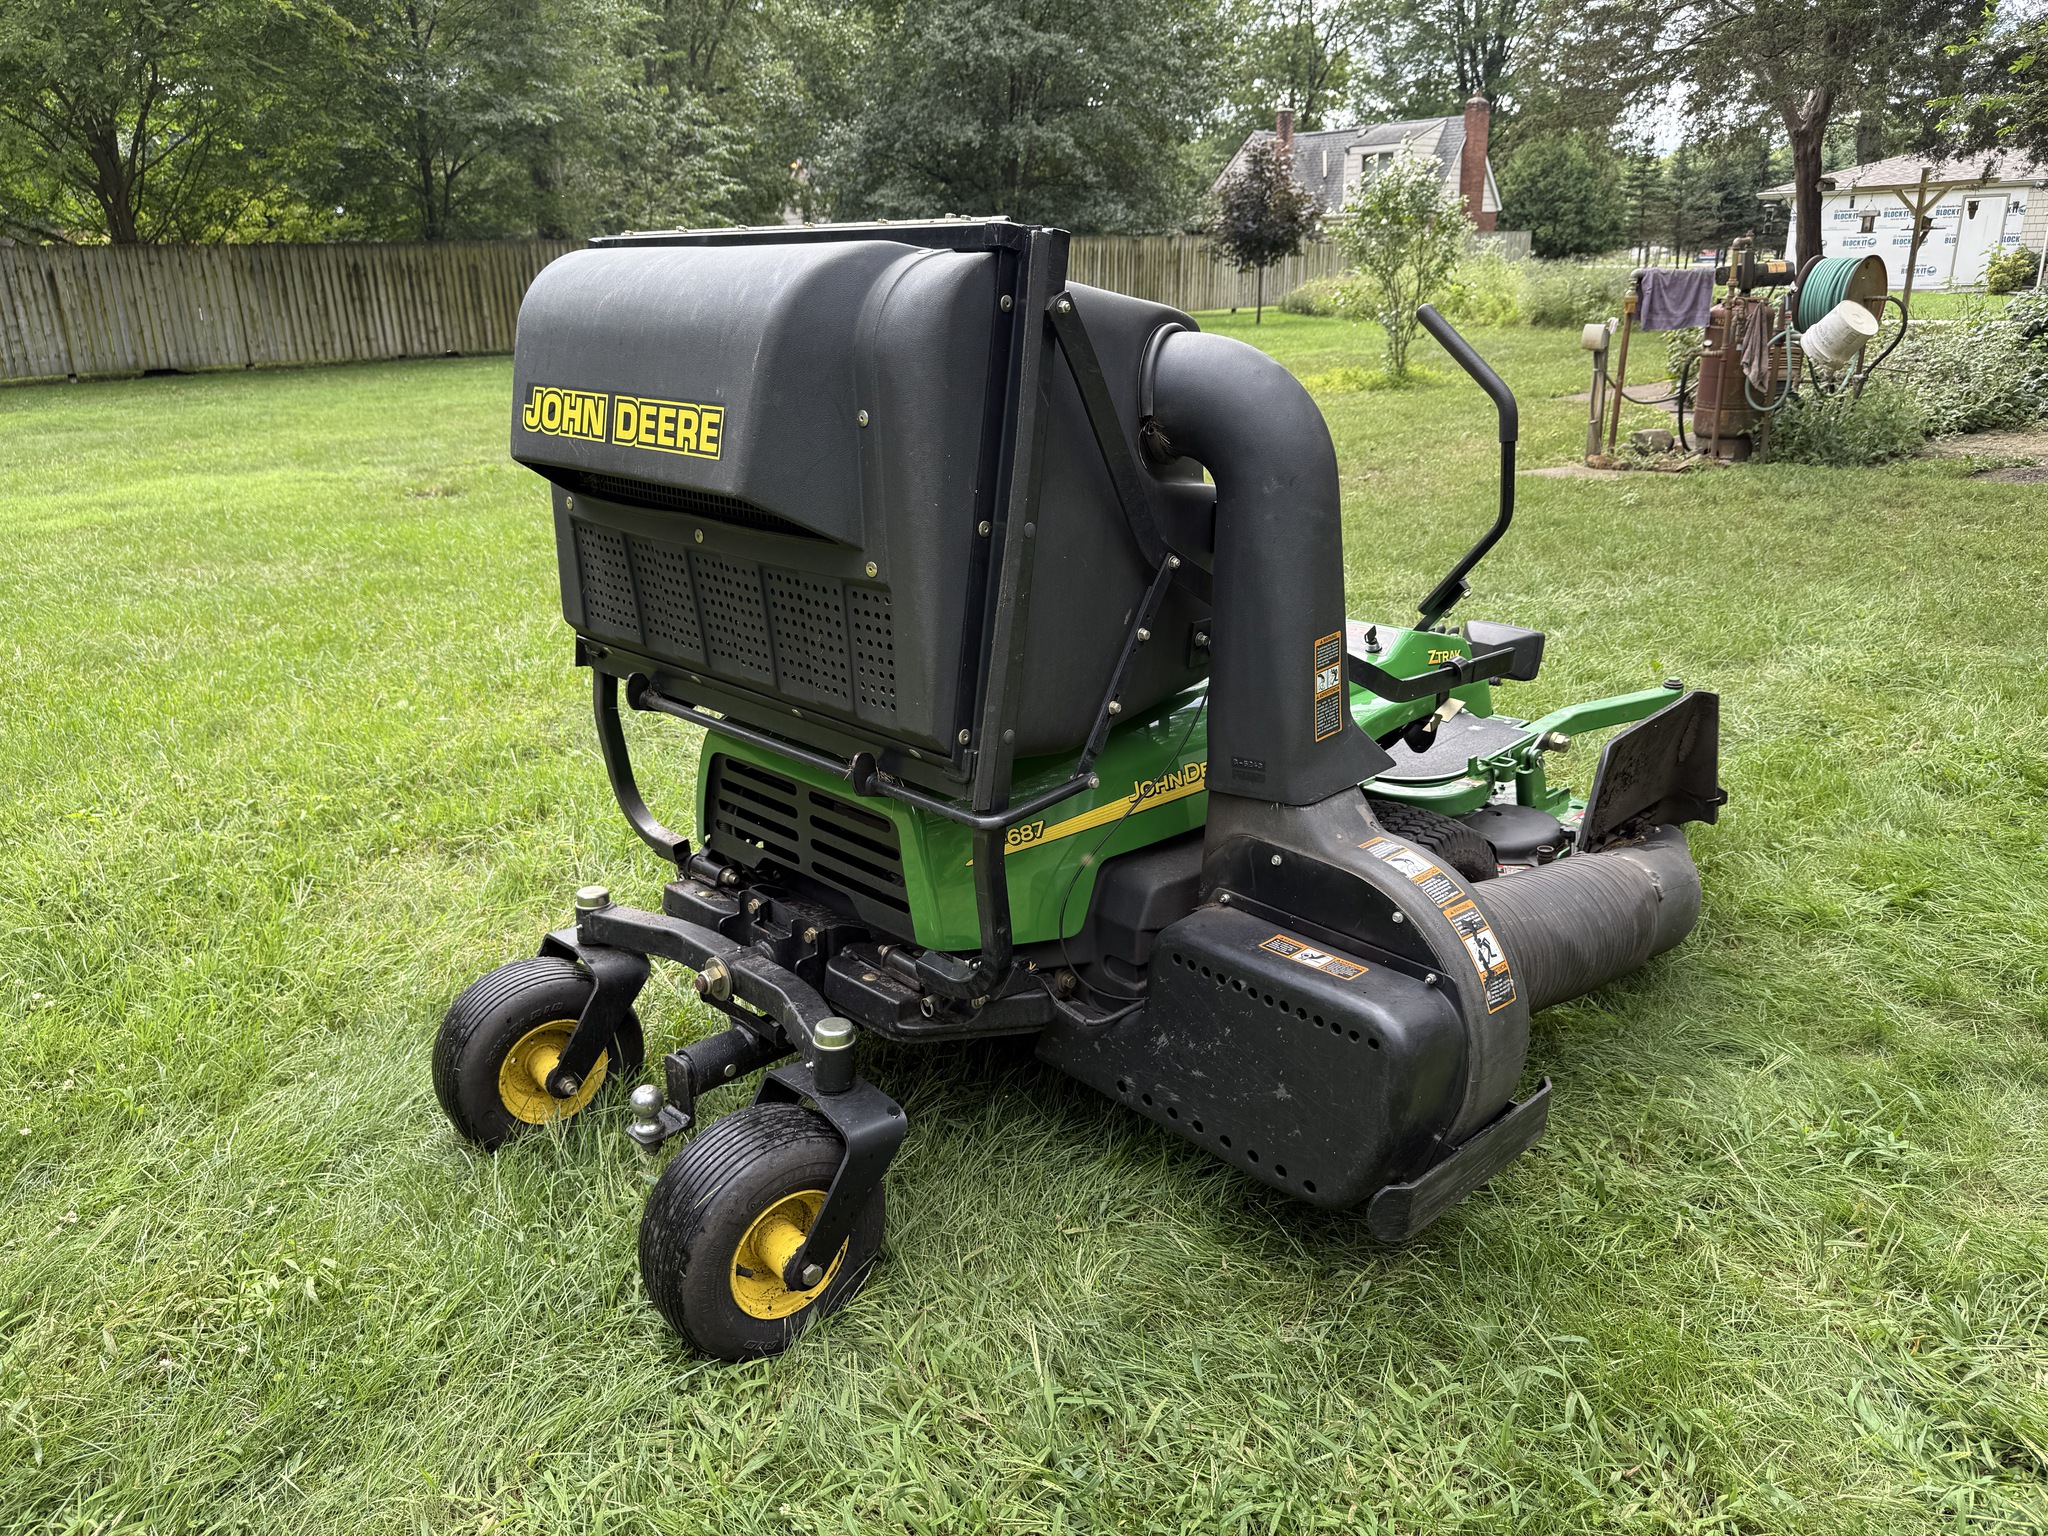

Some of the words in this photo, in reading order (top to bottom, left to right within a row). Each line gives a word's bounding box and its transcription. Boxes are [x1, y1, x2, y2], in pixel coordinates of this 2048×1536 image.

[1833, 212, 1852, 220] BLOCK
[1883, 210, 1902, 218] BLOCK
[1935, 208, 1955, 216] BLOCK
[523, 387, 608, 442] JOHN
[613, 396, 724, 460] DEERE
[1128, 770, 1185, 803] JOHN
